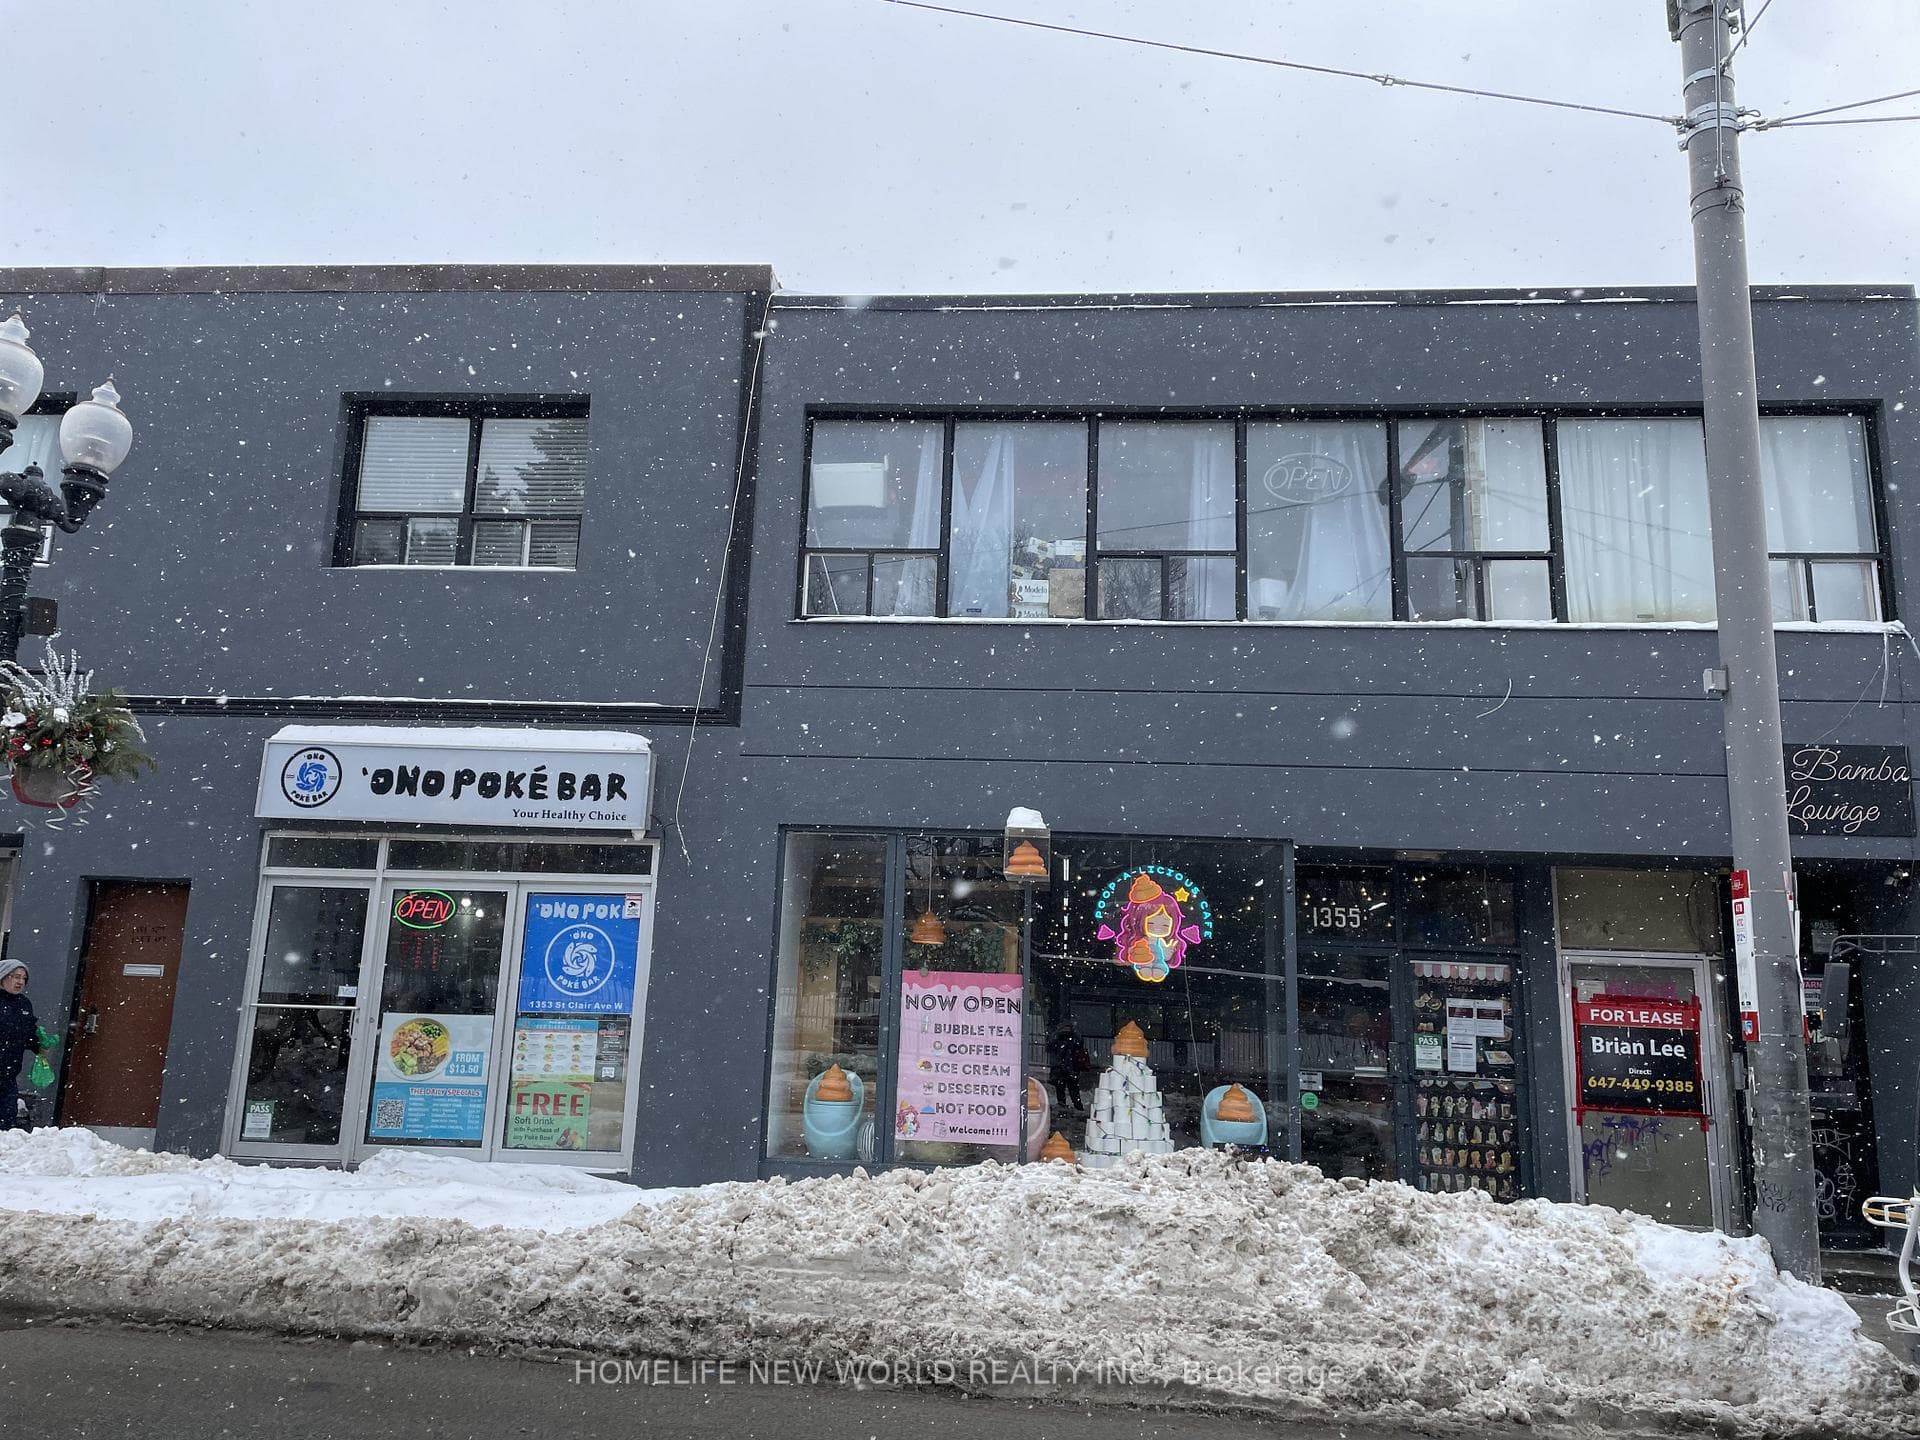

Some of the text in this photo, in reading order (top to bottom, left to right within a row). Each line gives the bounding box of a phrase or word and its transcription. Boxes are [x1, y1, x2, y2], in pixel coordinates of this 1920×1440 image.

[1269, 465, 1345, 491] OPEN
[1024, 585, 1048, 593] Modelo
[1791, 748, 1911, 782] Bamba
[450, 764, 549, 800] POKÉ
[557, 771, 628, 802] BAR
[311, 790, 329, 802] BAR
[512, 808, 628, 823] Your Healthy Choice
[1787, 785, 1881, 833] Lounge
[398, 899, 451, 919] OPEN
[1095, 865, 1213, 940] POOP-A-LICIOUS CAFE
[582, 902, 627, 920] POK
[1312, 907, 1362, 928] 1355
[529, 1000, 624, 1010] 1353 St Clair Ave W
[905, 994, 1021, 1014] NOW OPEN
[1590, 1008, 1683, 1025] FOR LEASE
[934, 1023, 1014, 1038] BUBBLE TEA
[1418, 1036, 1439, 1046] PASS
[1591, 1036, 1686, 1057] Brian Lee
[946, 1043, 1000, 1057] COFFEE
[455, 1053, 480, 1063] FROM
[449, 1064, 479, 1074] $13.50
[934, 1062, 1011, 1077] ICE CREAM
[1628, 1067, 1652, 1075] Direct:
[937, 1082, 1006, 1097] DESSERTS
[1588, 1076, 1694, 1093] 647-449-9385
[409, 1087, 483, 1098] THE DAILY SPECIALS
[250, 1104, 271, 1113] PASS
[515, 1092, 585, 1117] FREE
[935, 1102, 1007, 1117] HOT FOOD
[514, 1116, 555, 1125] Soft Drink
[949, 1125, 1009, 1137] Welcome!!!!
